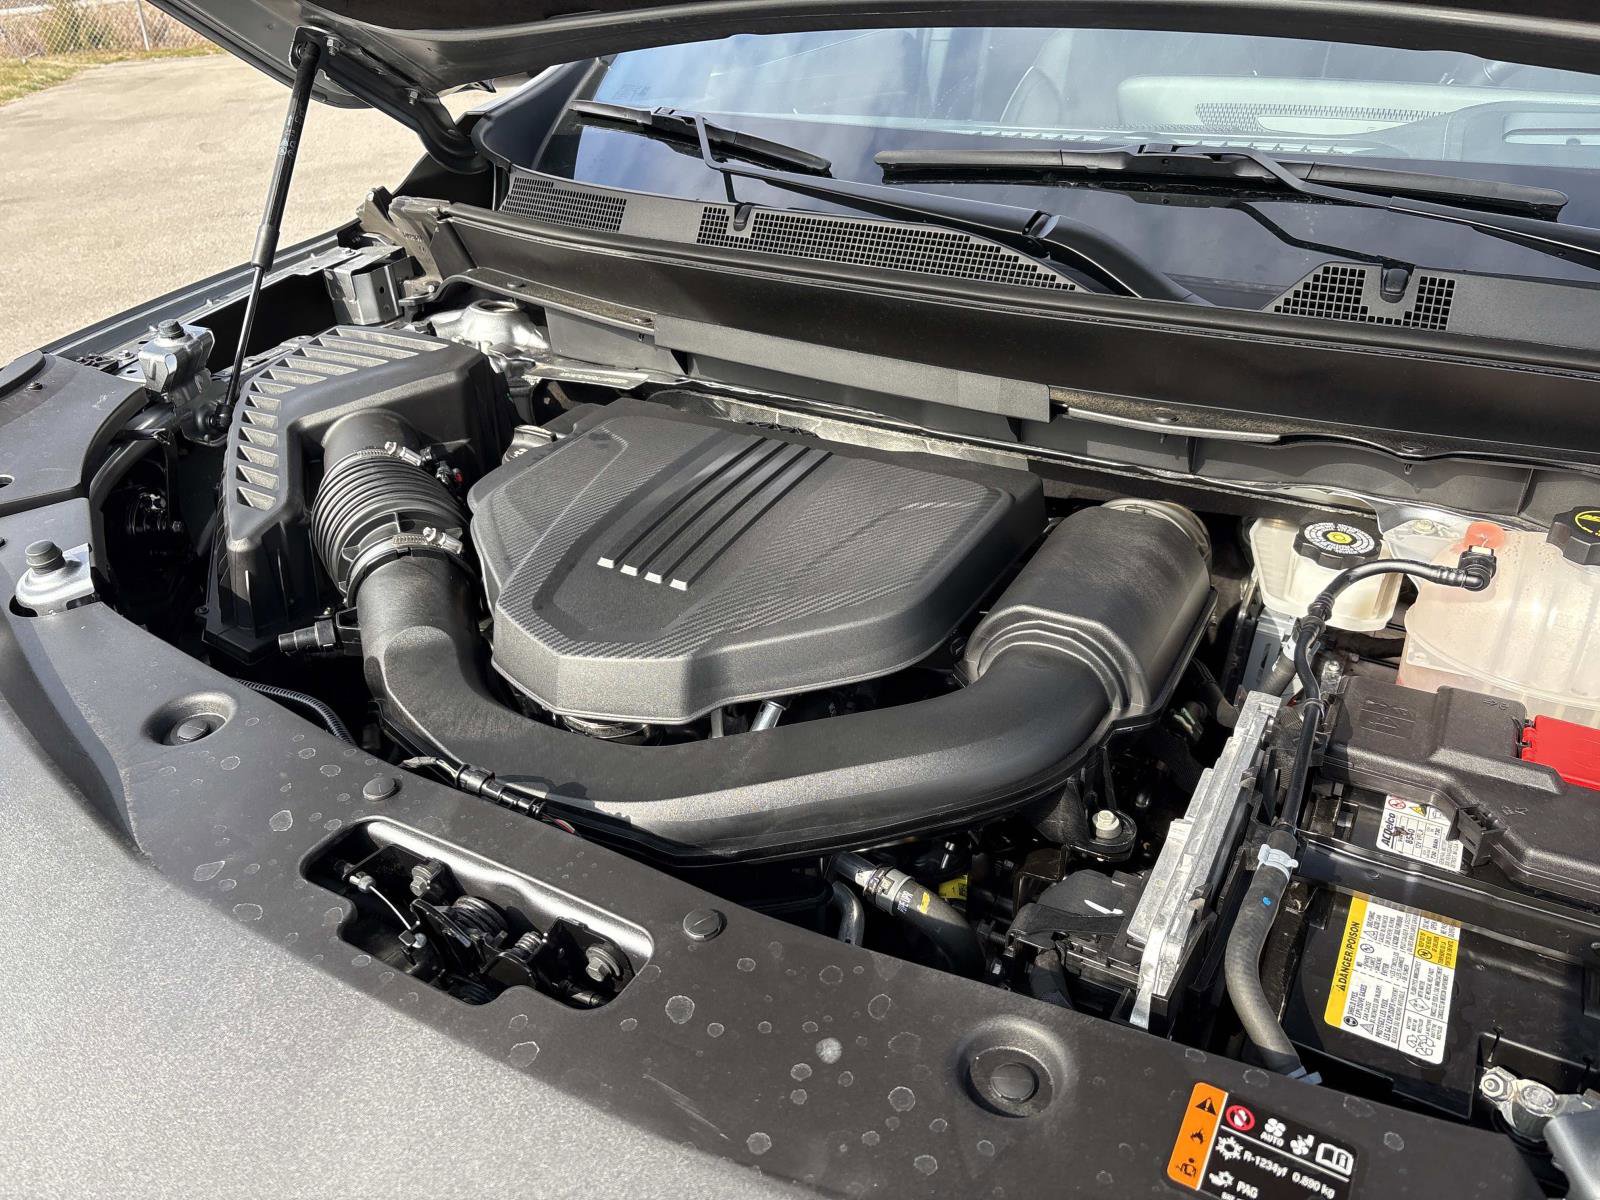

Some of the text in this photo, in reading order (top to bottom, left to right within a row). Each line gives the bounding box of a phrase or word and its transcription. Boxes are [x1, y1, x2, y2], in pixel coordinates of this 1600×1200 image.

[1381, 813, 1396, 846] ACDelco
[1338, 921, 1360, 985] DANGER/POISON
[1260, 1131, 1285, 1148] AUTO
[1236, 1180, 1259, 1199] PAG
[1243, 1151, 1289, 1178] R-1234yf
[1321, 1184, 1336, 1200] kg
